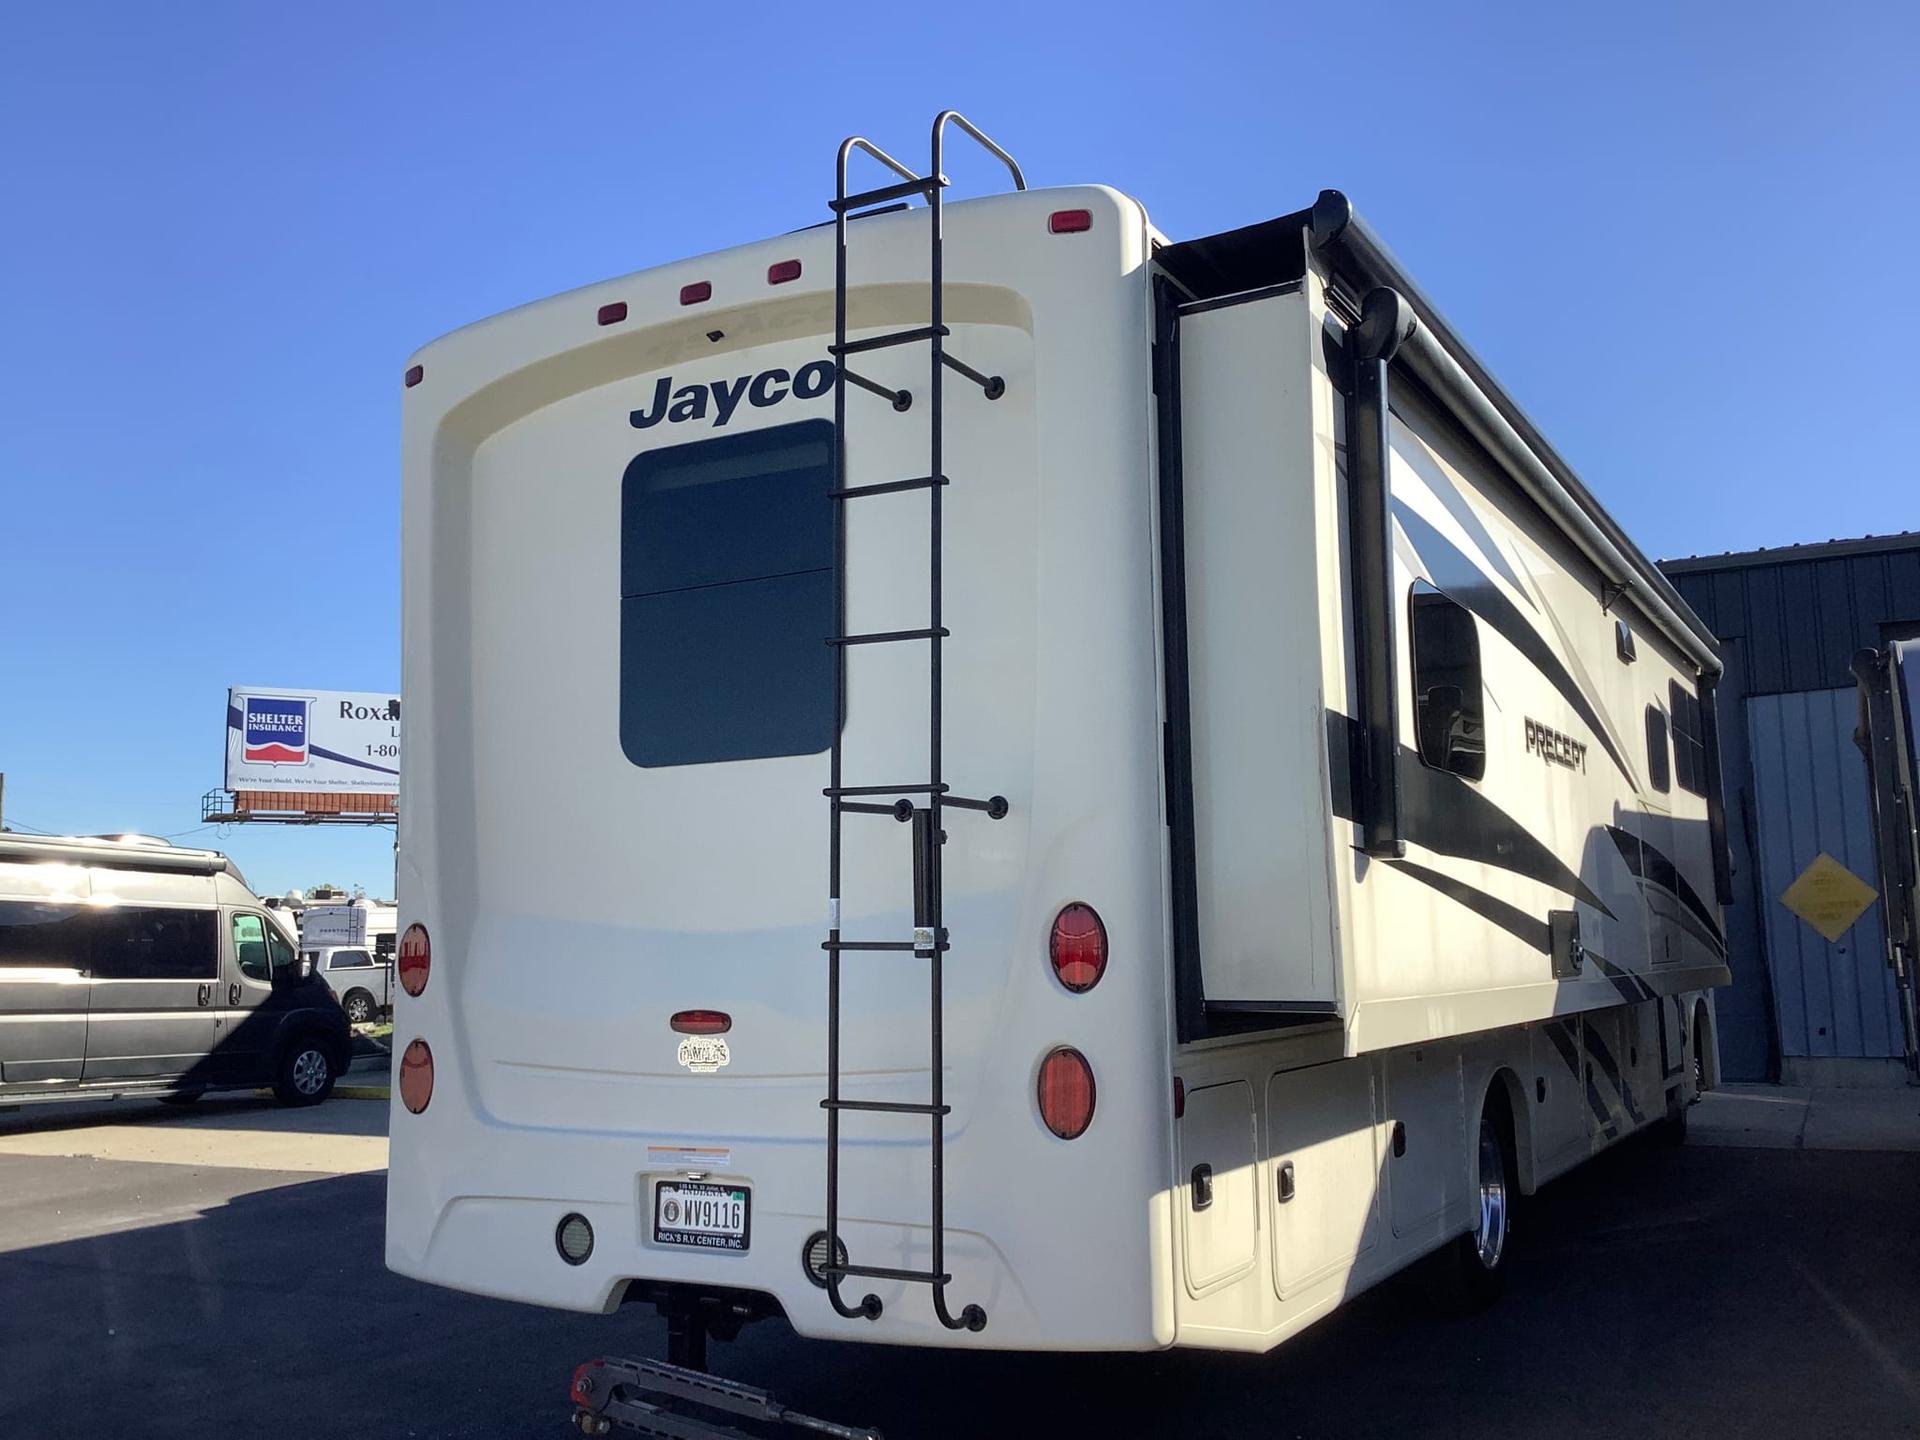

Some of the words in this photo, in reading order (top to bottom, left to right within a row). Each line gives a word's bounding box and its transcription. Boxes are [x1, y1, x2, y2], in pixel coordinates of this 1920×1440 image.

[629, 359, 837, 429] Jayco
[248, 712, 304, 725] SHELTER
[340, 701, 400, 721] Roxa
[248, 723, 304, 733] INSURANCE
[391, 726, 401, 738] L
[365, 744, 401, 757] 1-80
[1524, 715, 1588, 776] PRECEPT
[658, 1232, 681, 1243] RICK'S
[728, 1239, 743, 1249] INC.
